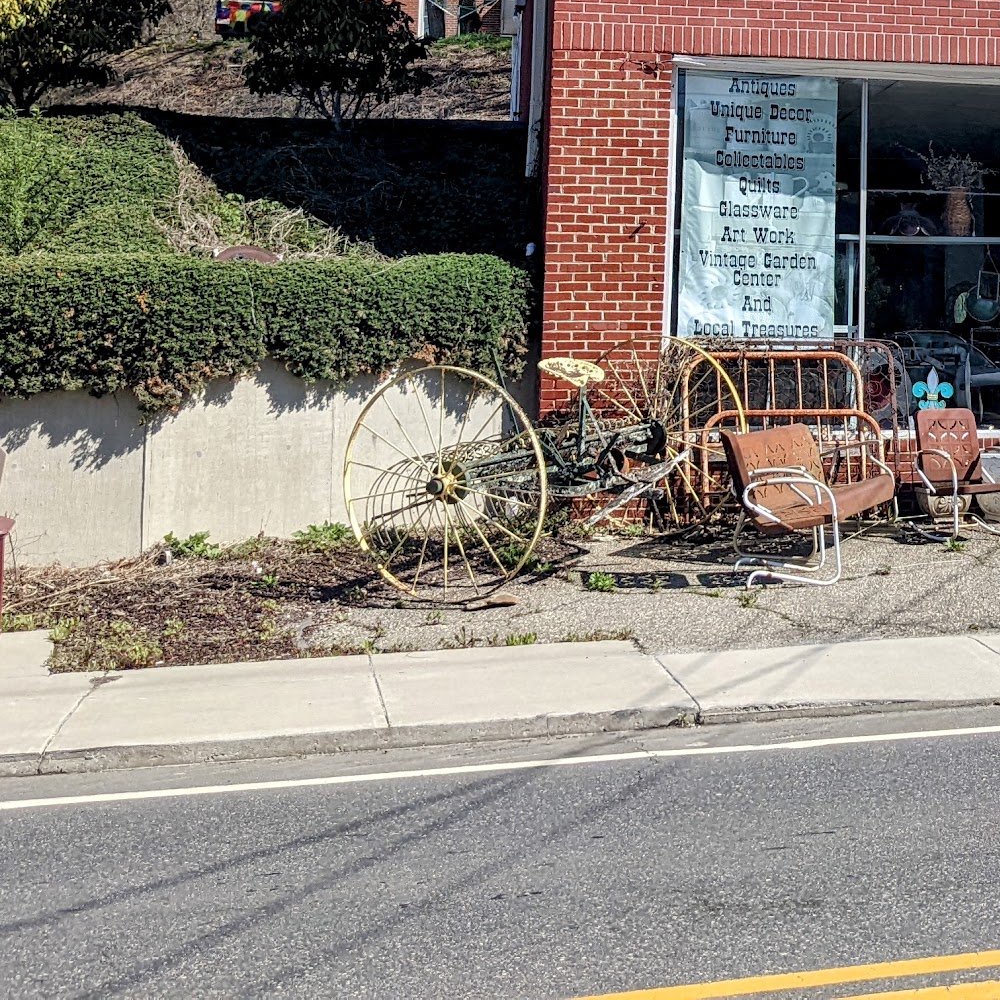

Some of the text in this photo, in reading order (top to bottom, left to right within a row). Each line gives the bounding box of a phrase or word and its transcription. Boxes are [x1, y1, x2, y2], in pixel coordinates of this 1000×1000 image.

[728, 78, 796, 98] Antiques
[710, 101, 813, 122] Unique Decor
[725, 126, 796, 145] Furniture
[716, 151, 804, 170] Collectables
[739, 177, 780, 195] Quilts
[719, 201, 798, 220] Glassware
[721, 226, 795, 244] Art Work
[699, 250, 817, 271] Vintage Garden
[733, 269, 781, 287] Center
[742, 296, 772, 312] And
[693, 319, 819, 339] Local Treasures
